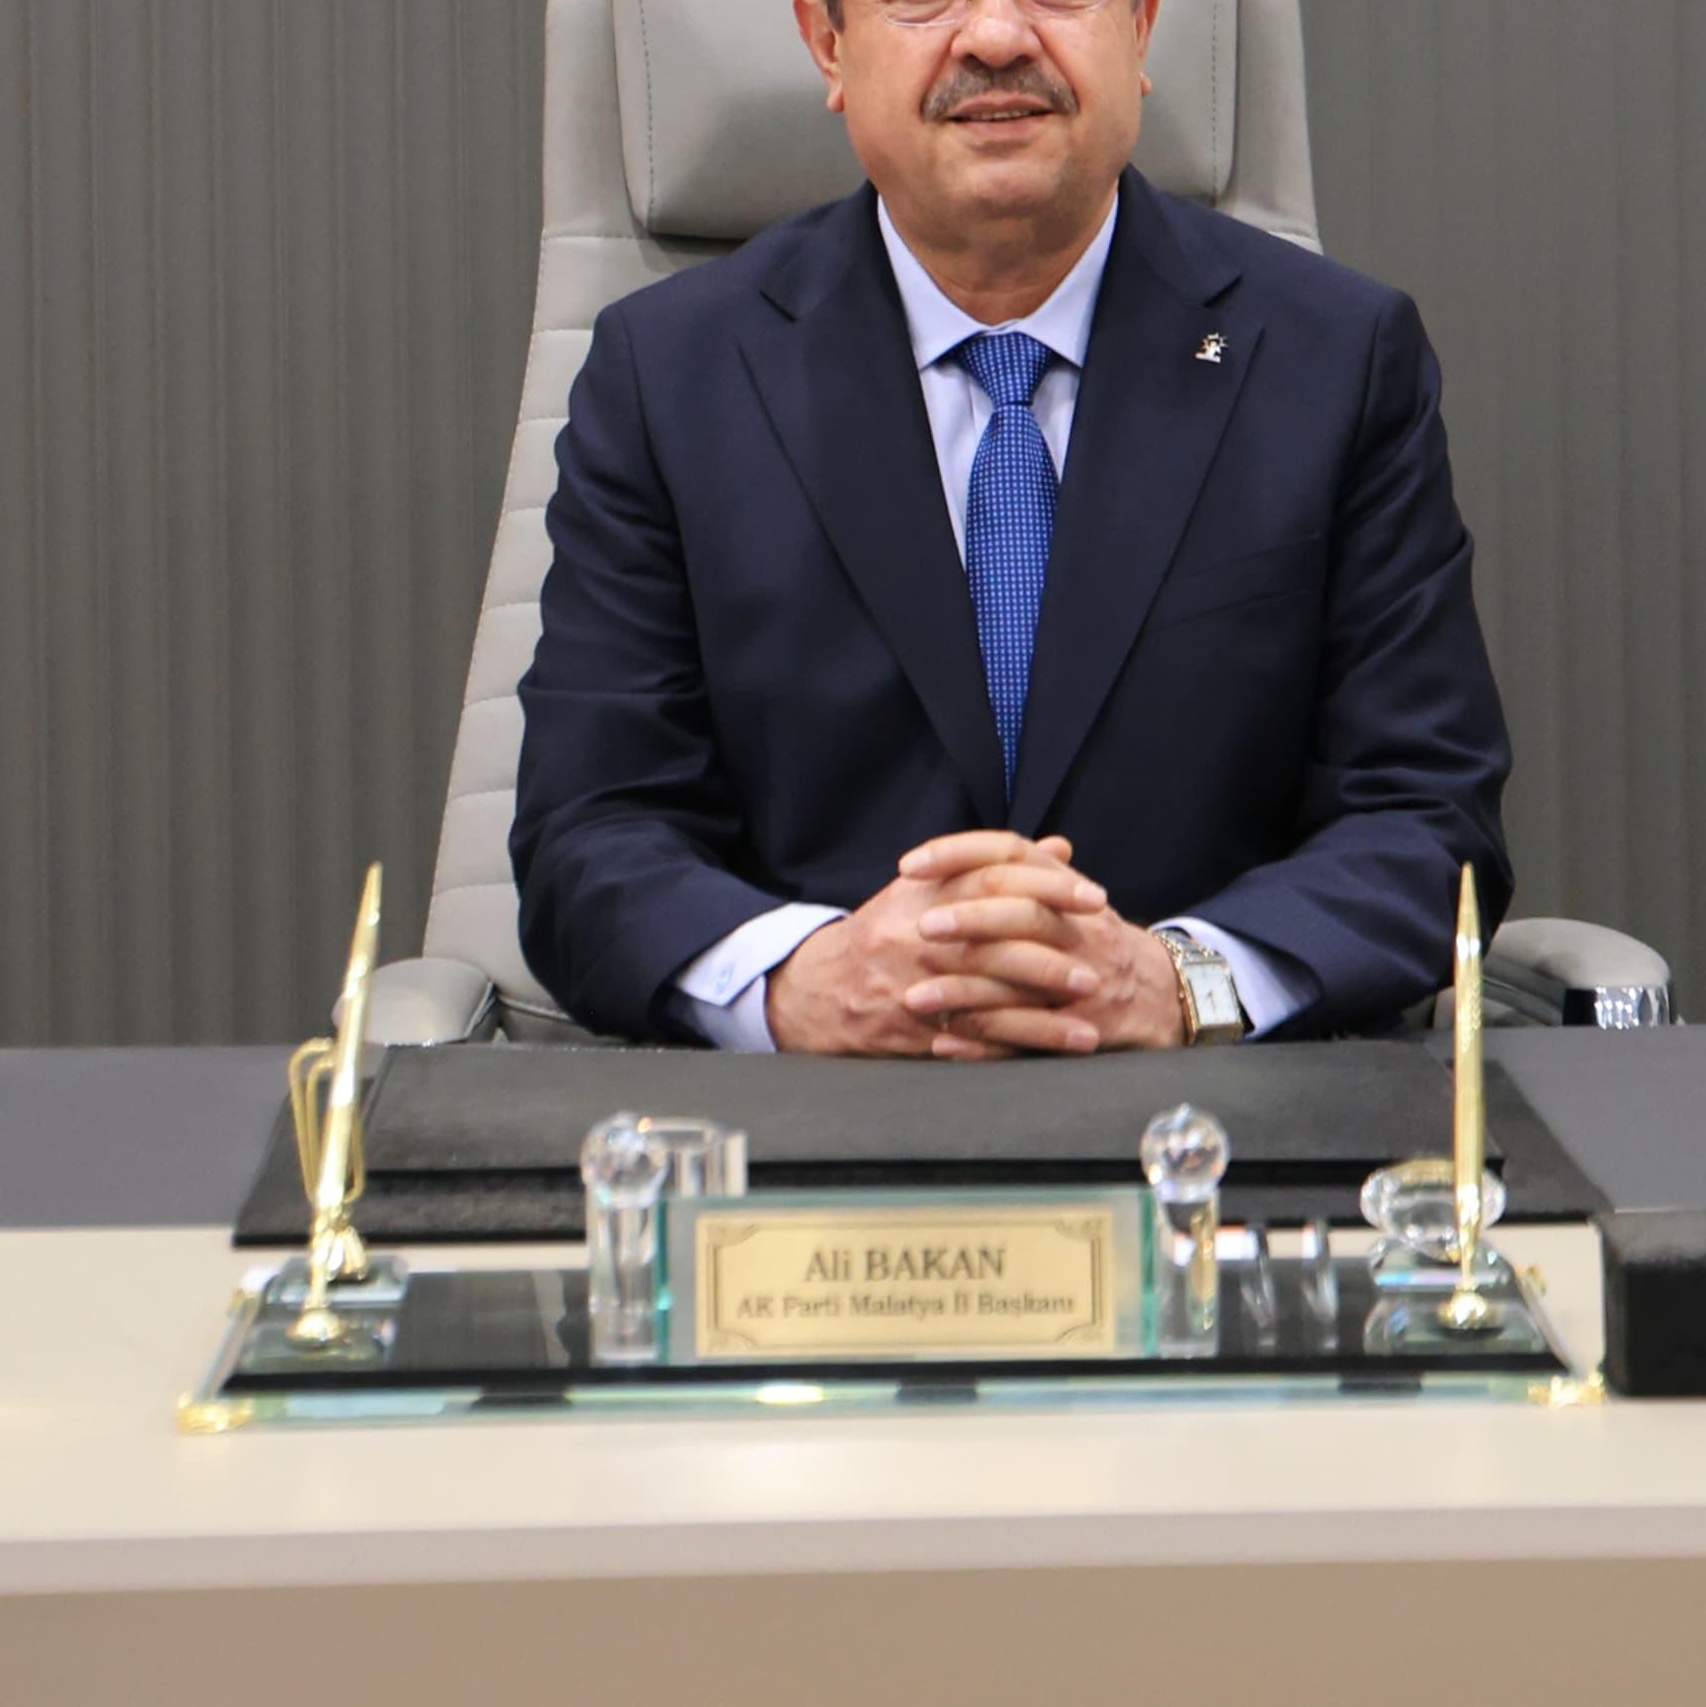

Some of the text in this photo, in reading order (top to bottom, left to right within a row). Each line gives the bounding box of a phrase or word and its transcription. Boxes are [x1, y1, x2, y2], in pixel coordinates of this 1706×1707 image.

[804, 1247, 1006, 1282] Ali BAKAN
[736, 1297, 774, 1319] AK
[782, 1295, 840, 1318] Parti
[849, 1294, 945, 1322] Malatya
